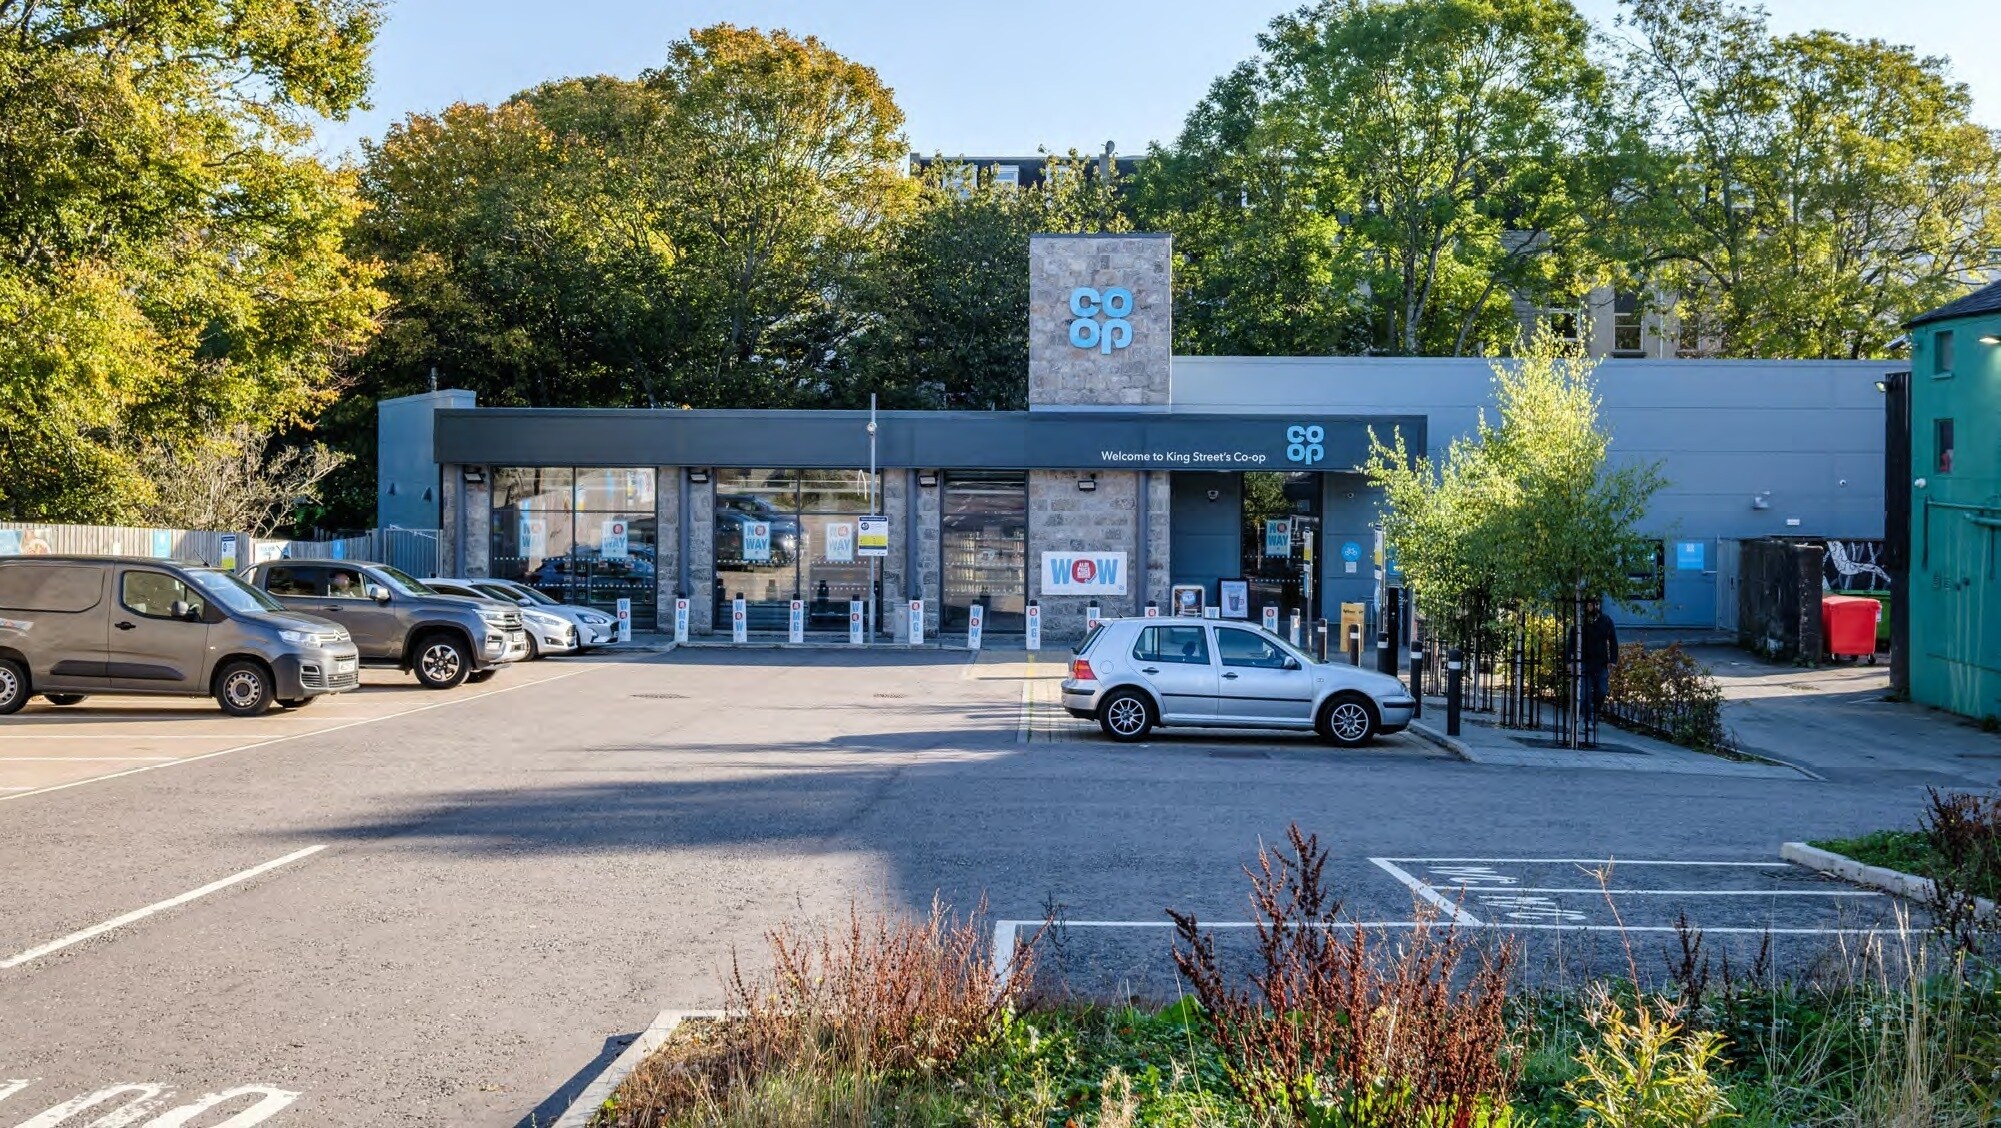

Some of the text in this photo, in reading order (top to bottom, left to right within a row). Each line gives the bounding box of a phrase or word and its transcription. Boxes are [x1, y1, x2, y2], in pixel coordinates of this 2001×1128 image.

[1101, 451, 1266, 464] Welcome to King Street's Co-op
[745, 538, 768, 550] WAY
[828, 539, 851, 551] WAY
[1268, 535, 1288, 546] WAY
[1050, 558, 1118, 585] WOW
